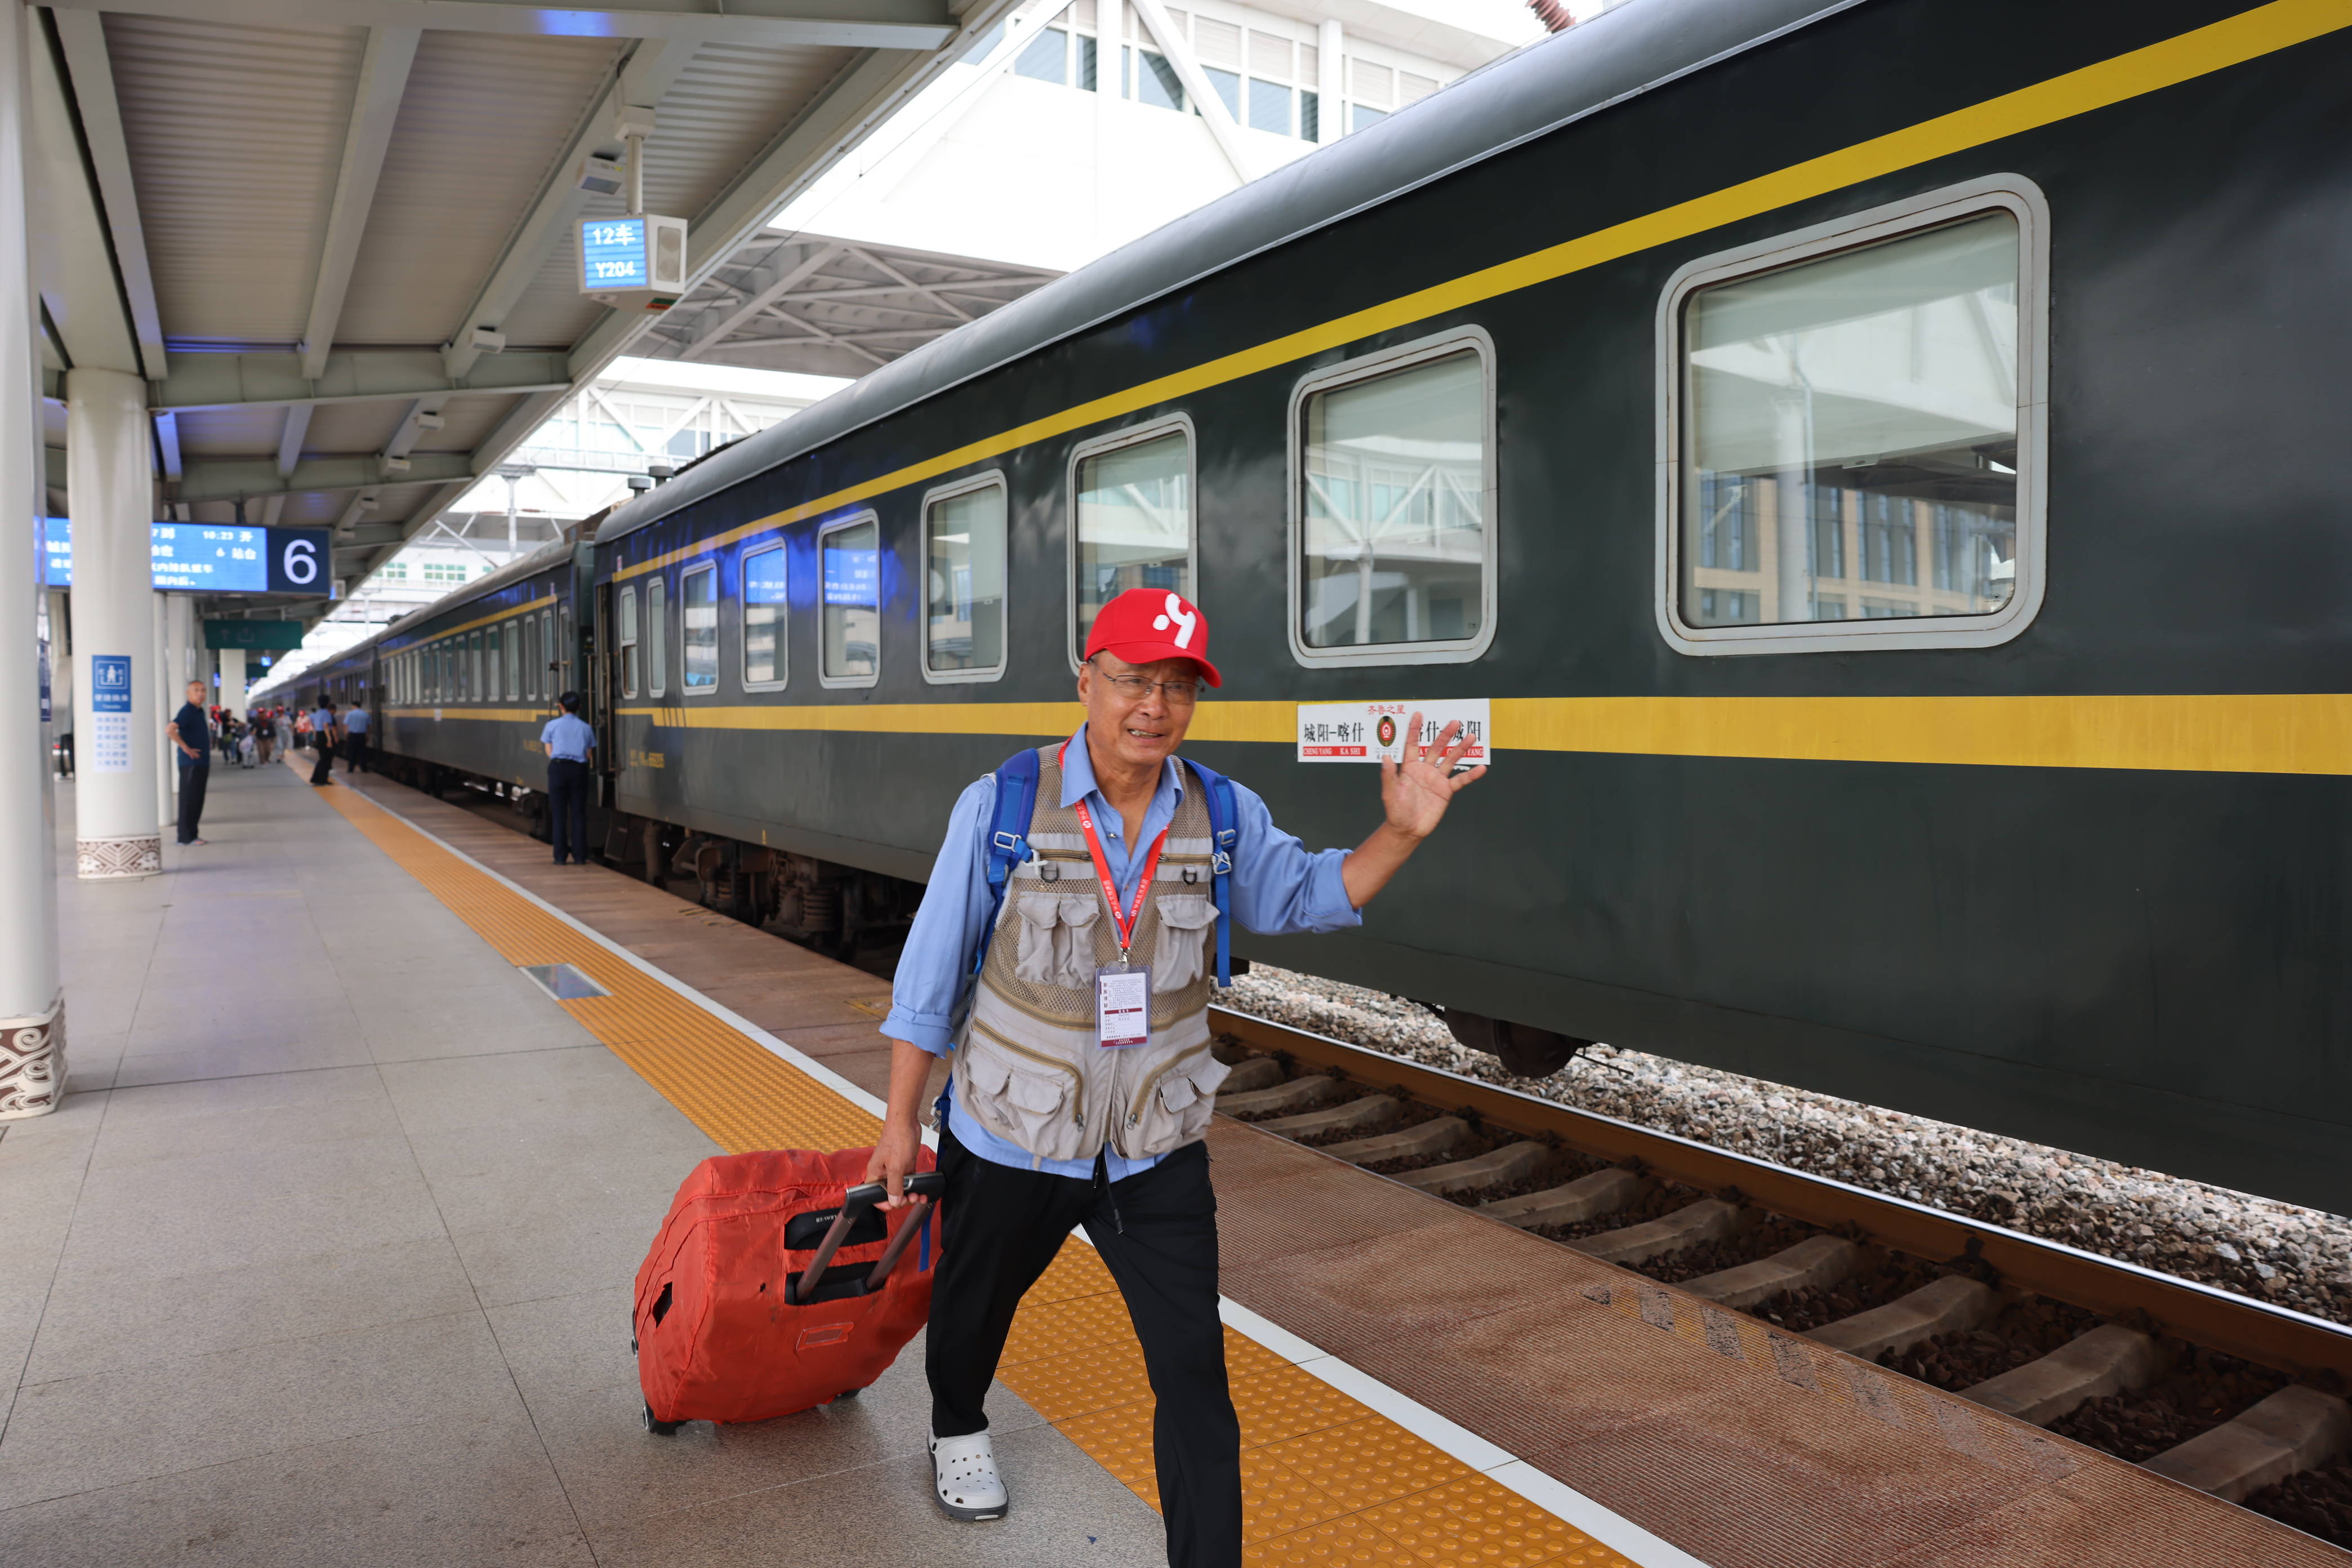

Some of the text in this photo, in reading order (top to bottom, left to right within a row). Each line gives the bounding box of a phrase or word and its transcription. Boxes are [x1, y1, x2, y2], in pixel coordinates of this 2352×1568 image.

[593, 224, 636, 246] 12车
[595, 260, 636, 278] Y204
[283, 539, 317, 584] 6
[1367, 705, 1406, 715] 齐鲁之星
[1304, 722, 1364, 742] 城阳-喀什
[1467, 748, 1483, 756] YANG
